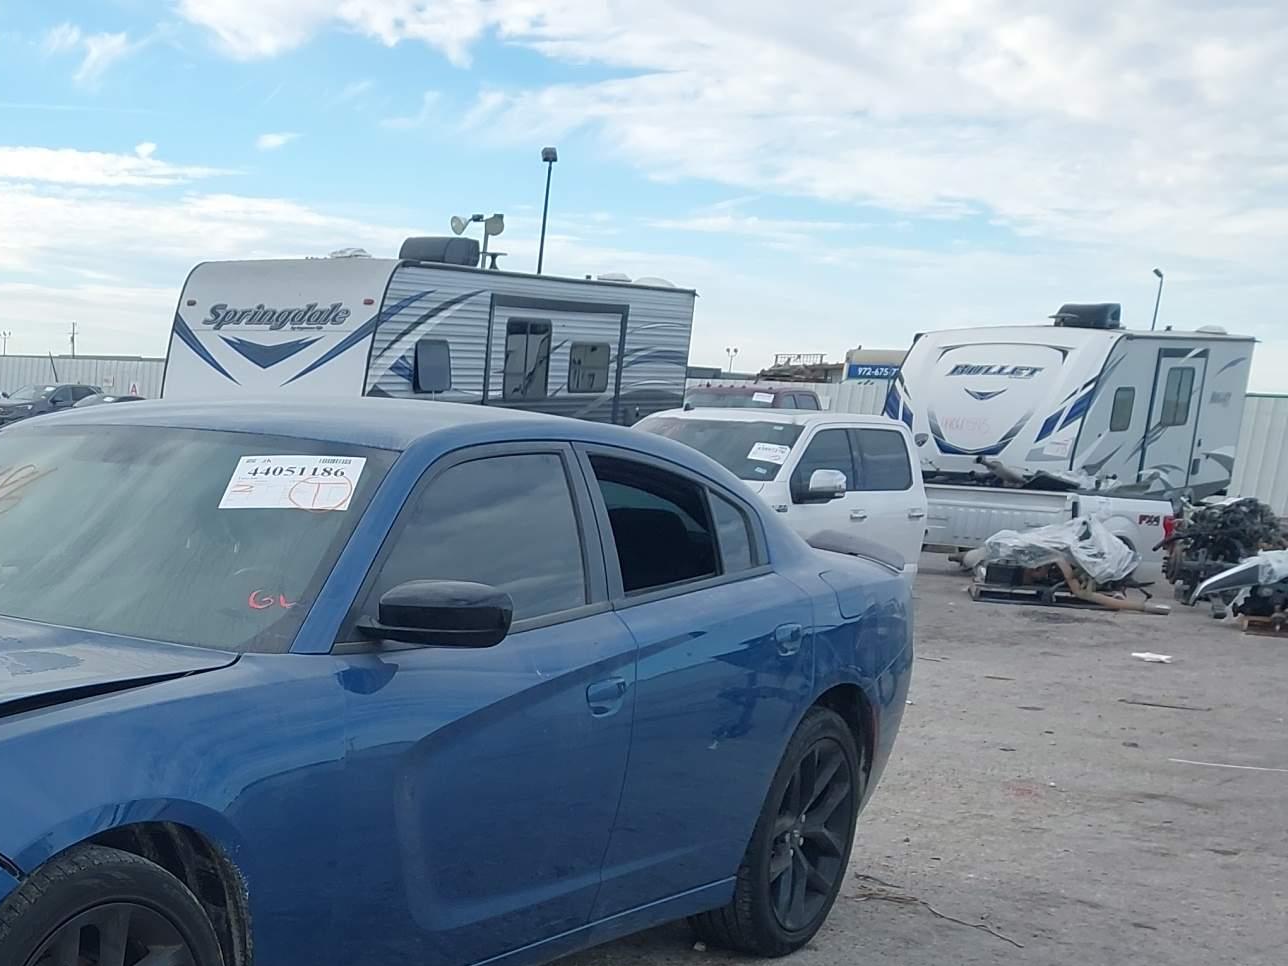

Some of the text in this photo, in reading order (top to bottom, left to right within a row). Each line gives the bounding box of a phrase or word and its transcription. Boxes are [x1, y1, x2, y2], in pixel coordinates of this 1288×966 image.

[202, 302, 352, 331] Springdale
[945, 364, 1045, 380] BULLET
[247, 465, 346, 478] 44051186
